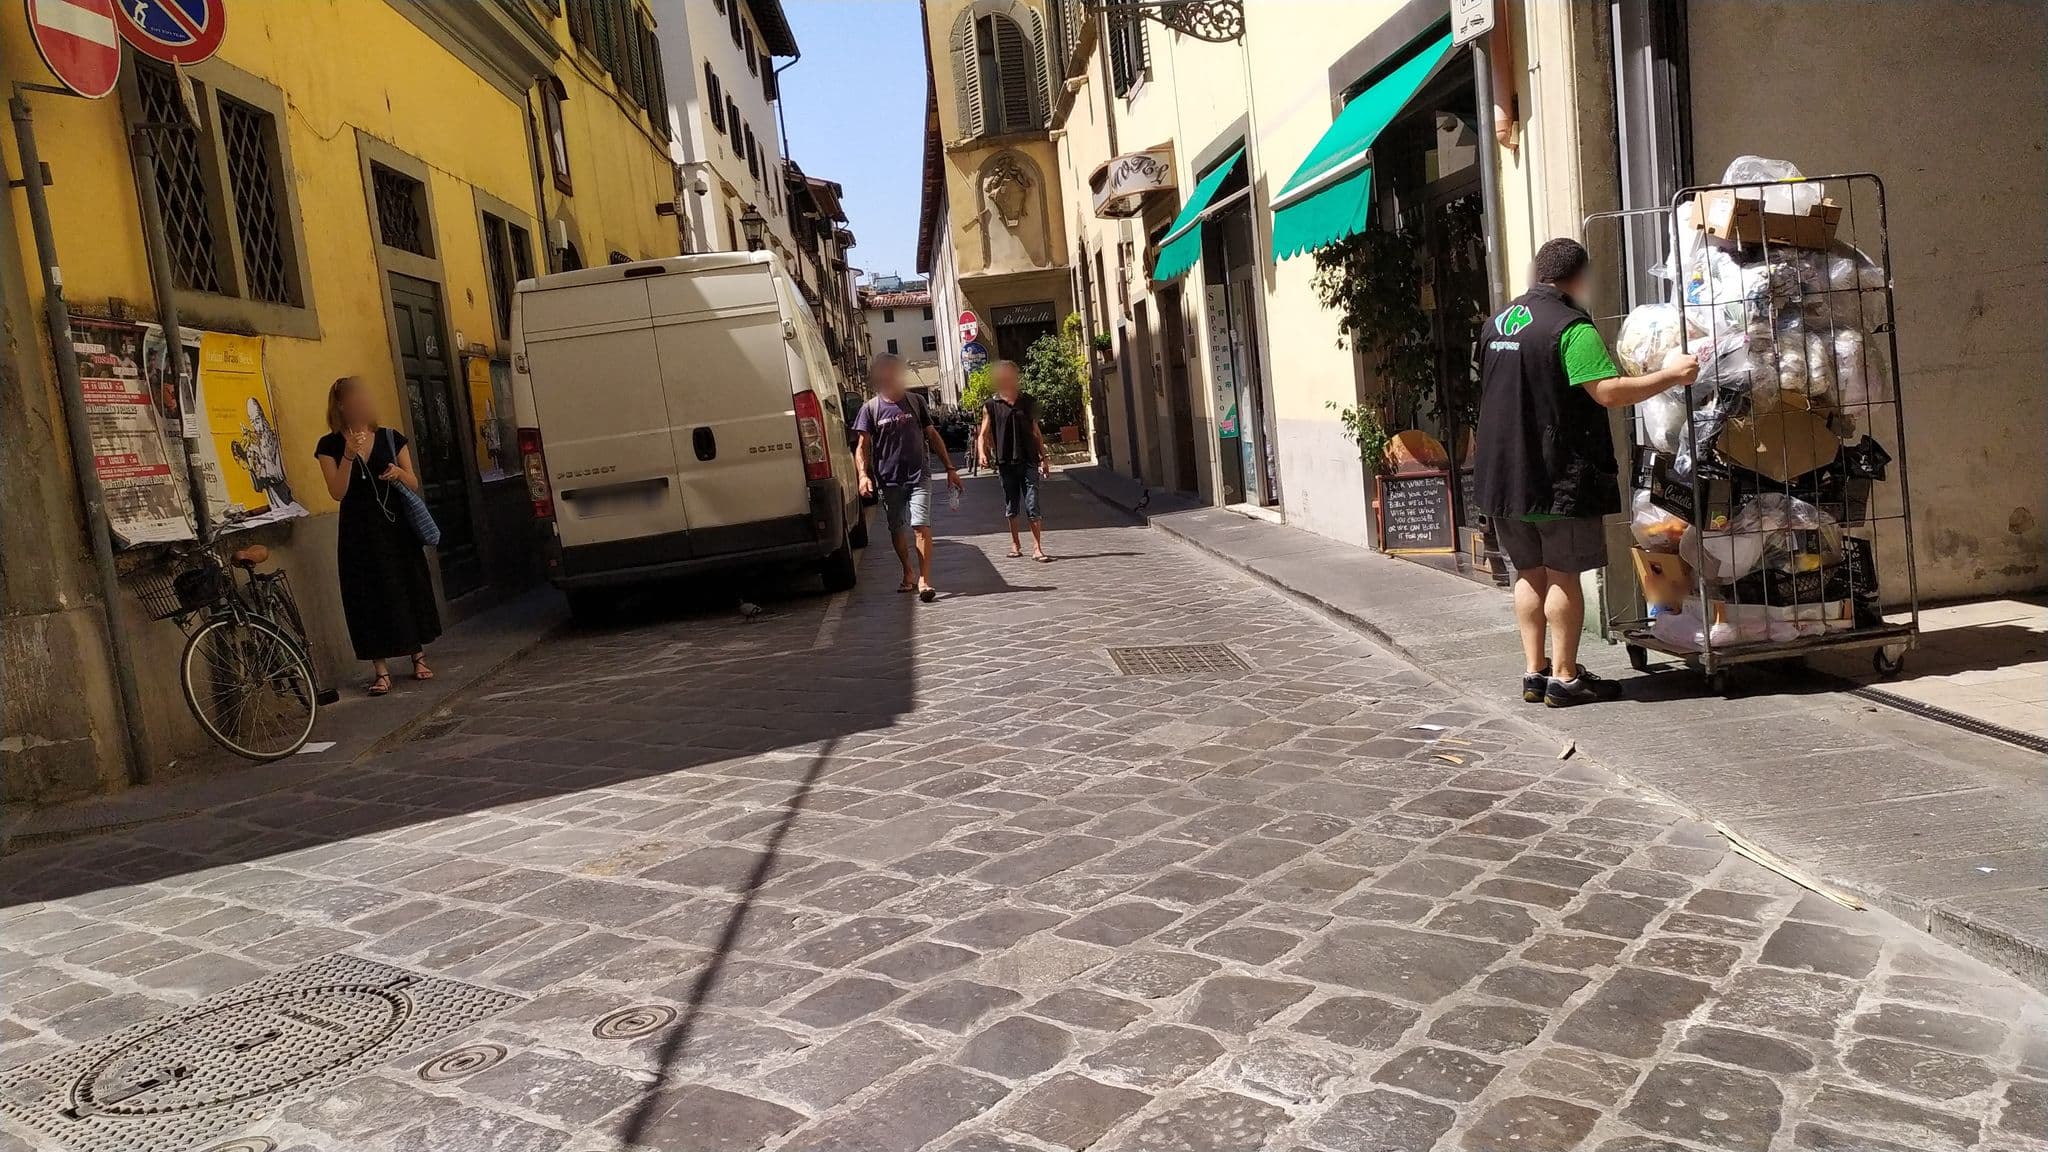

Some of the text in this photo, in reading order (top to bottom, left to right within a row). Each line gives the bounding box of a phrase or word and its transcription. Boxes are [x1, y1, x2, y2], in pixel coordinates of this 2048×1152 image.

[1110, 155, 1170, 190] HOTEL
[1012, 305, 1033, 314] Hotel
[998, 311, 1050, 327] Botticelli
[1208, 292, 1226, 412] Supermercato
[749, 441, 794, 455] BOXER
[556, 464, 617, 480] PEUGEOT
